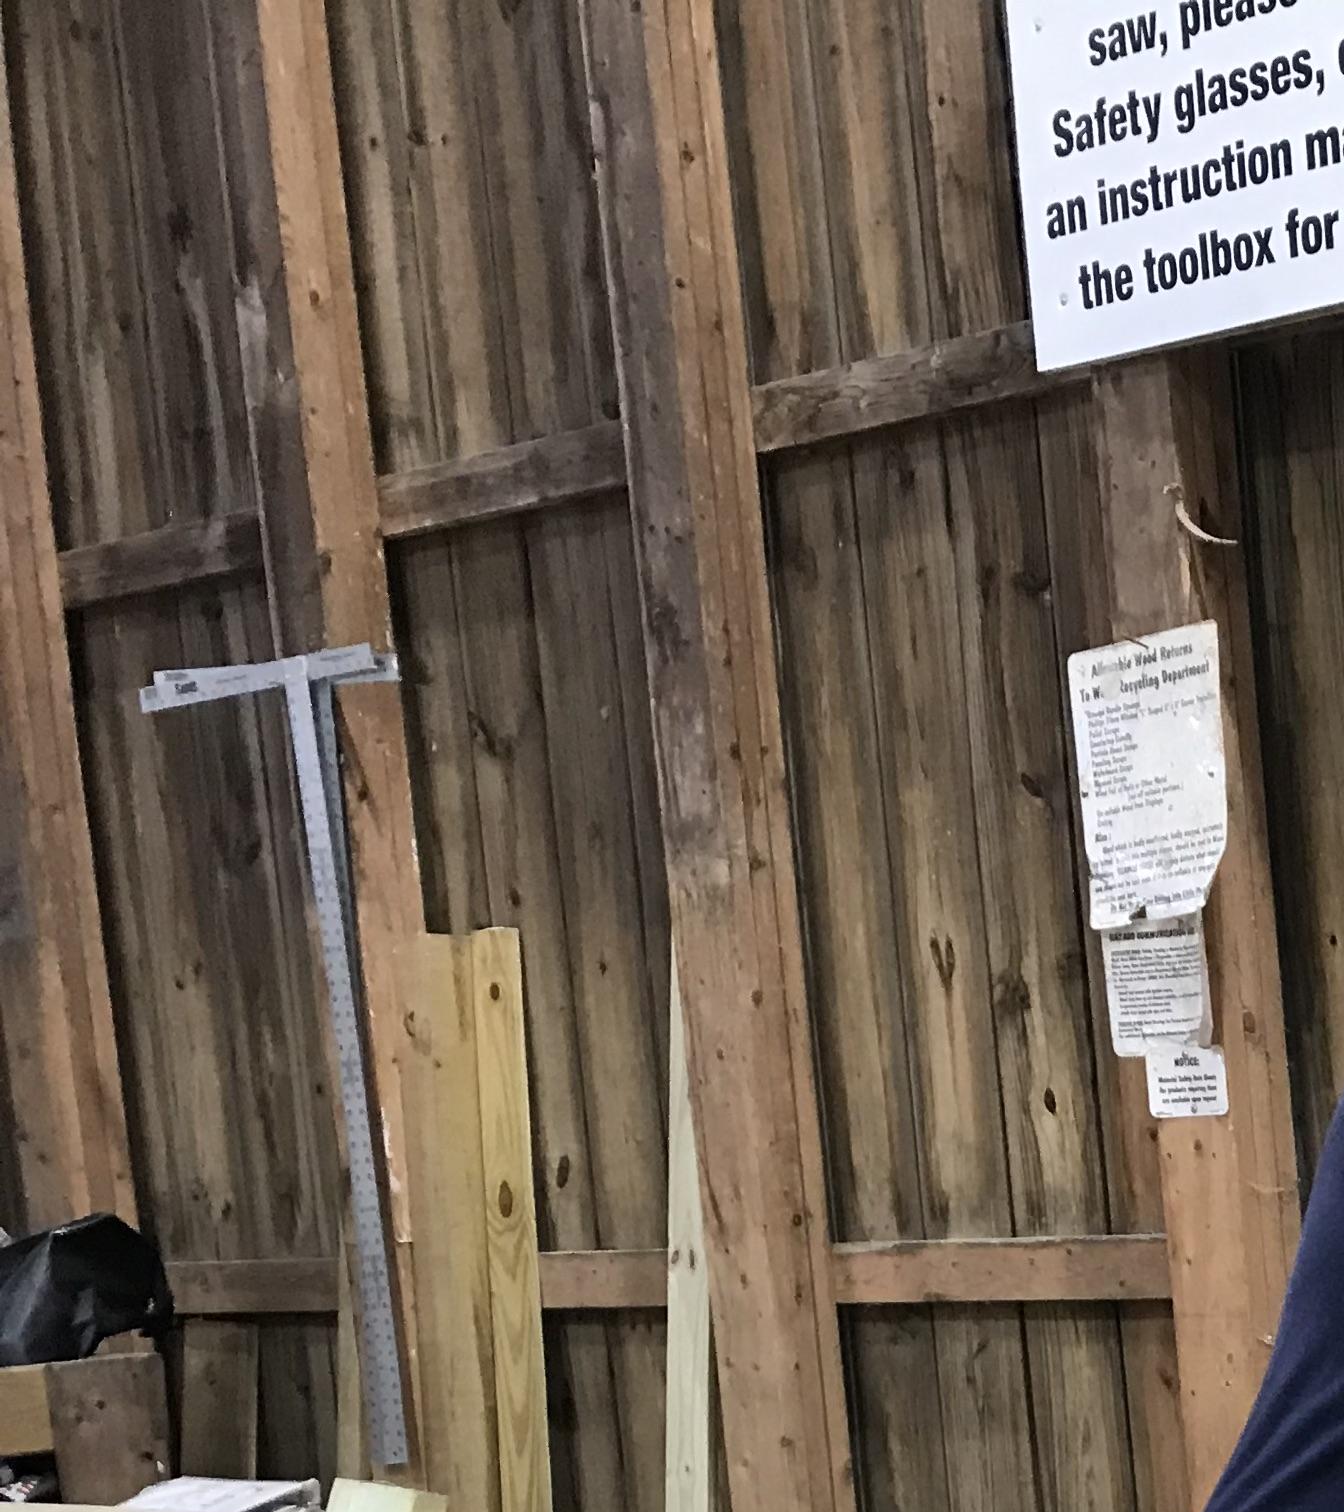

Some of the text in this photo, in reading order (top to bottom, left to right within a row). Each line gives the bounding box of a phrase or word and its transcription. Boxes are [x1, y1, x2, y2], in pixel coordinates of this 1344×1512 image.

[1088, 11, 1168, 66] saw,
[1053, 90, 1162, 158] Safety
[1174, 48, 1325, 134] glasses,
[1046, 194, 1088, 239] an
[1097, 138, 1293, 226] instruction
[1078, 260, 1134, 309] the
[1143, 226, 1276, 293] toolbox
[1285, 208, 1339, 258] for
